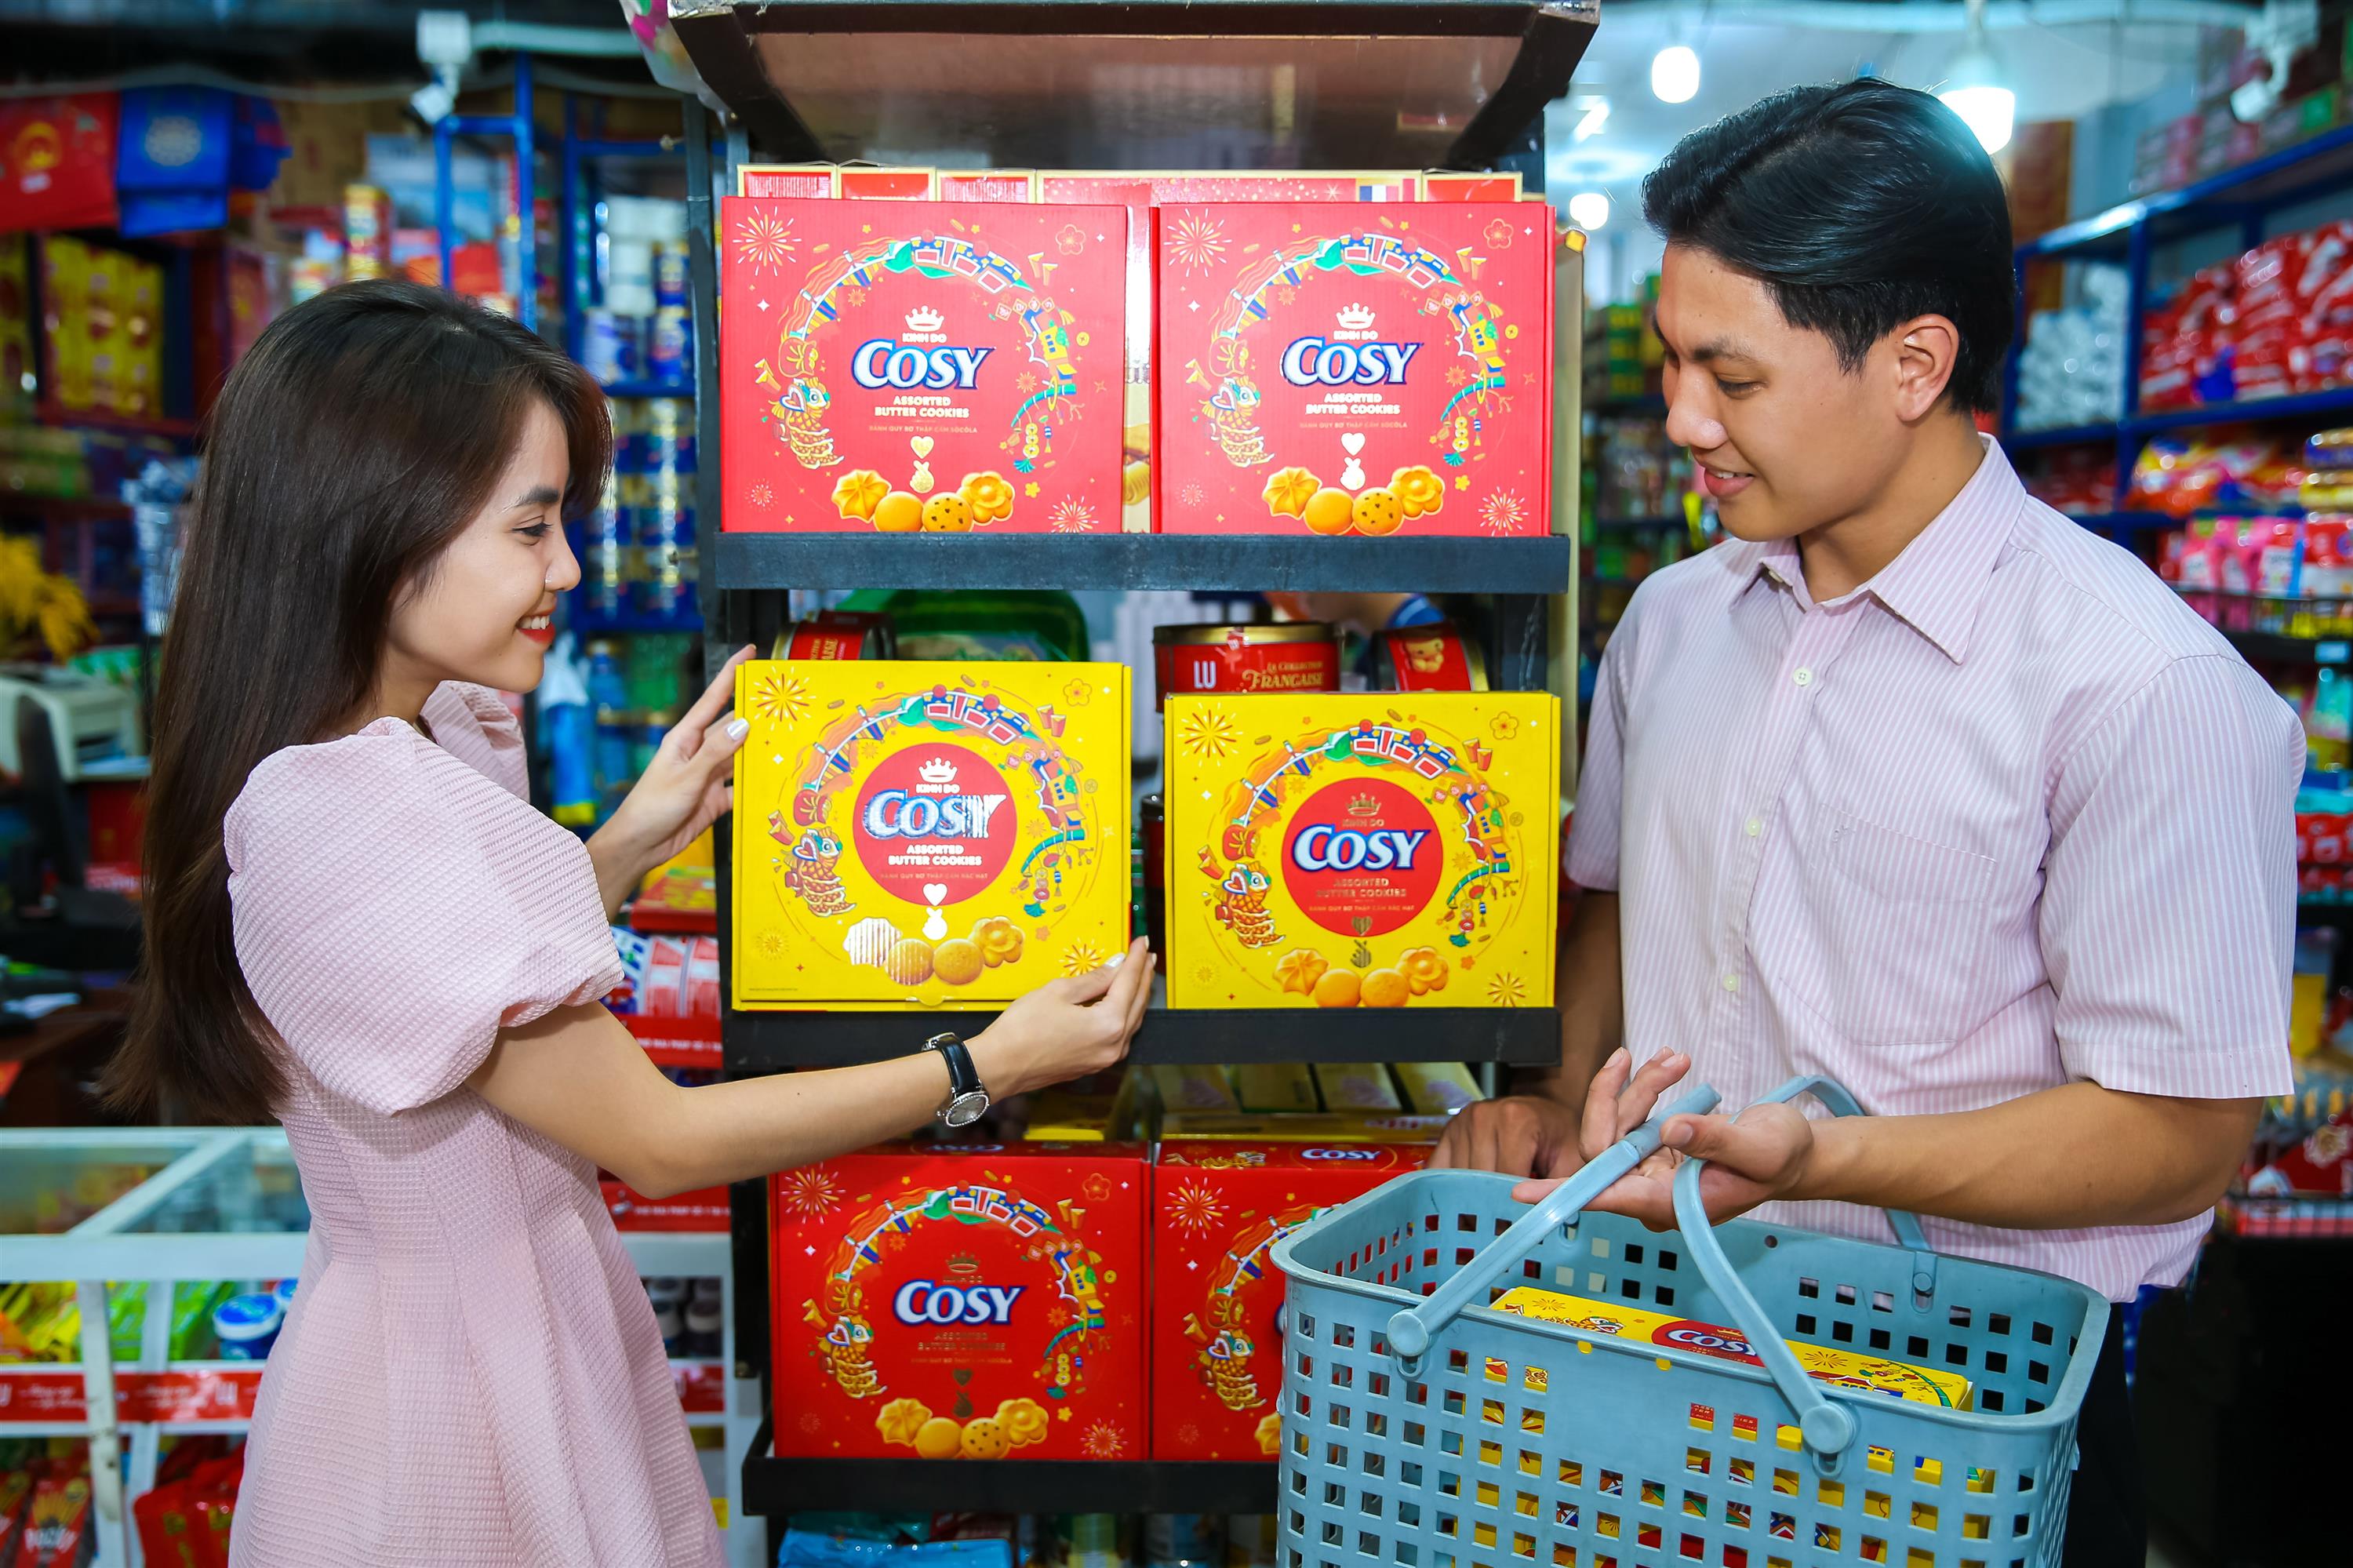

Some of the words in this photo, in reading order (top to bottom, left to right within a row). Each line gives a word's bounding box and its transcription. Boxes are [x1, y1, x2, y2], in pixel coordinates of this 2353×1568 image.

[902, 333, 929, 343] KINH
[930, 333, 947, 343] DO
[1333, 330, 1360, 340] KINH
[851, 338, 995, 390] COSY
[1281, 337, 1423, 387] COSY
[893, 395, 951, 406] ASSORTED
[1324, 393, 1382, 403] ASSORTED
[875, 407, 917, 417] BUTTER
[919, 407, 969, 418] COOKIES
[1305, 404, 1348, 414] BUTTER
[1350, 404, 1401, 414] COOKIES
[1194, 660, 1217, 689] LU
[915, 784, 942, 794] KINH
[863, 788, 1007, 840] COSY
[906, 845, 965, 855] ASSORTED
[1291, 824, 1431, 872] COSY
[888, 856, 930, 865] BUTTER
[932, 856, 983, 866] COOKIES
[1333, 878, 1390, 887] ASSORTED
[1360, 889, 1406, 897] COOKIES
[1301, 1148, 1381, 1160] COSY
[892, 1279, 1028, 1326] COSY
